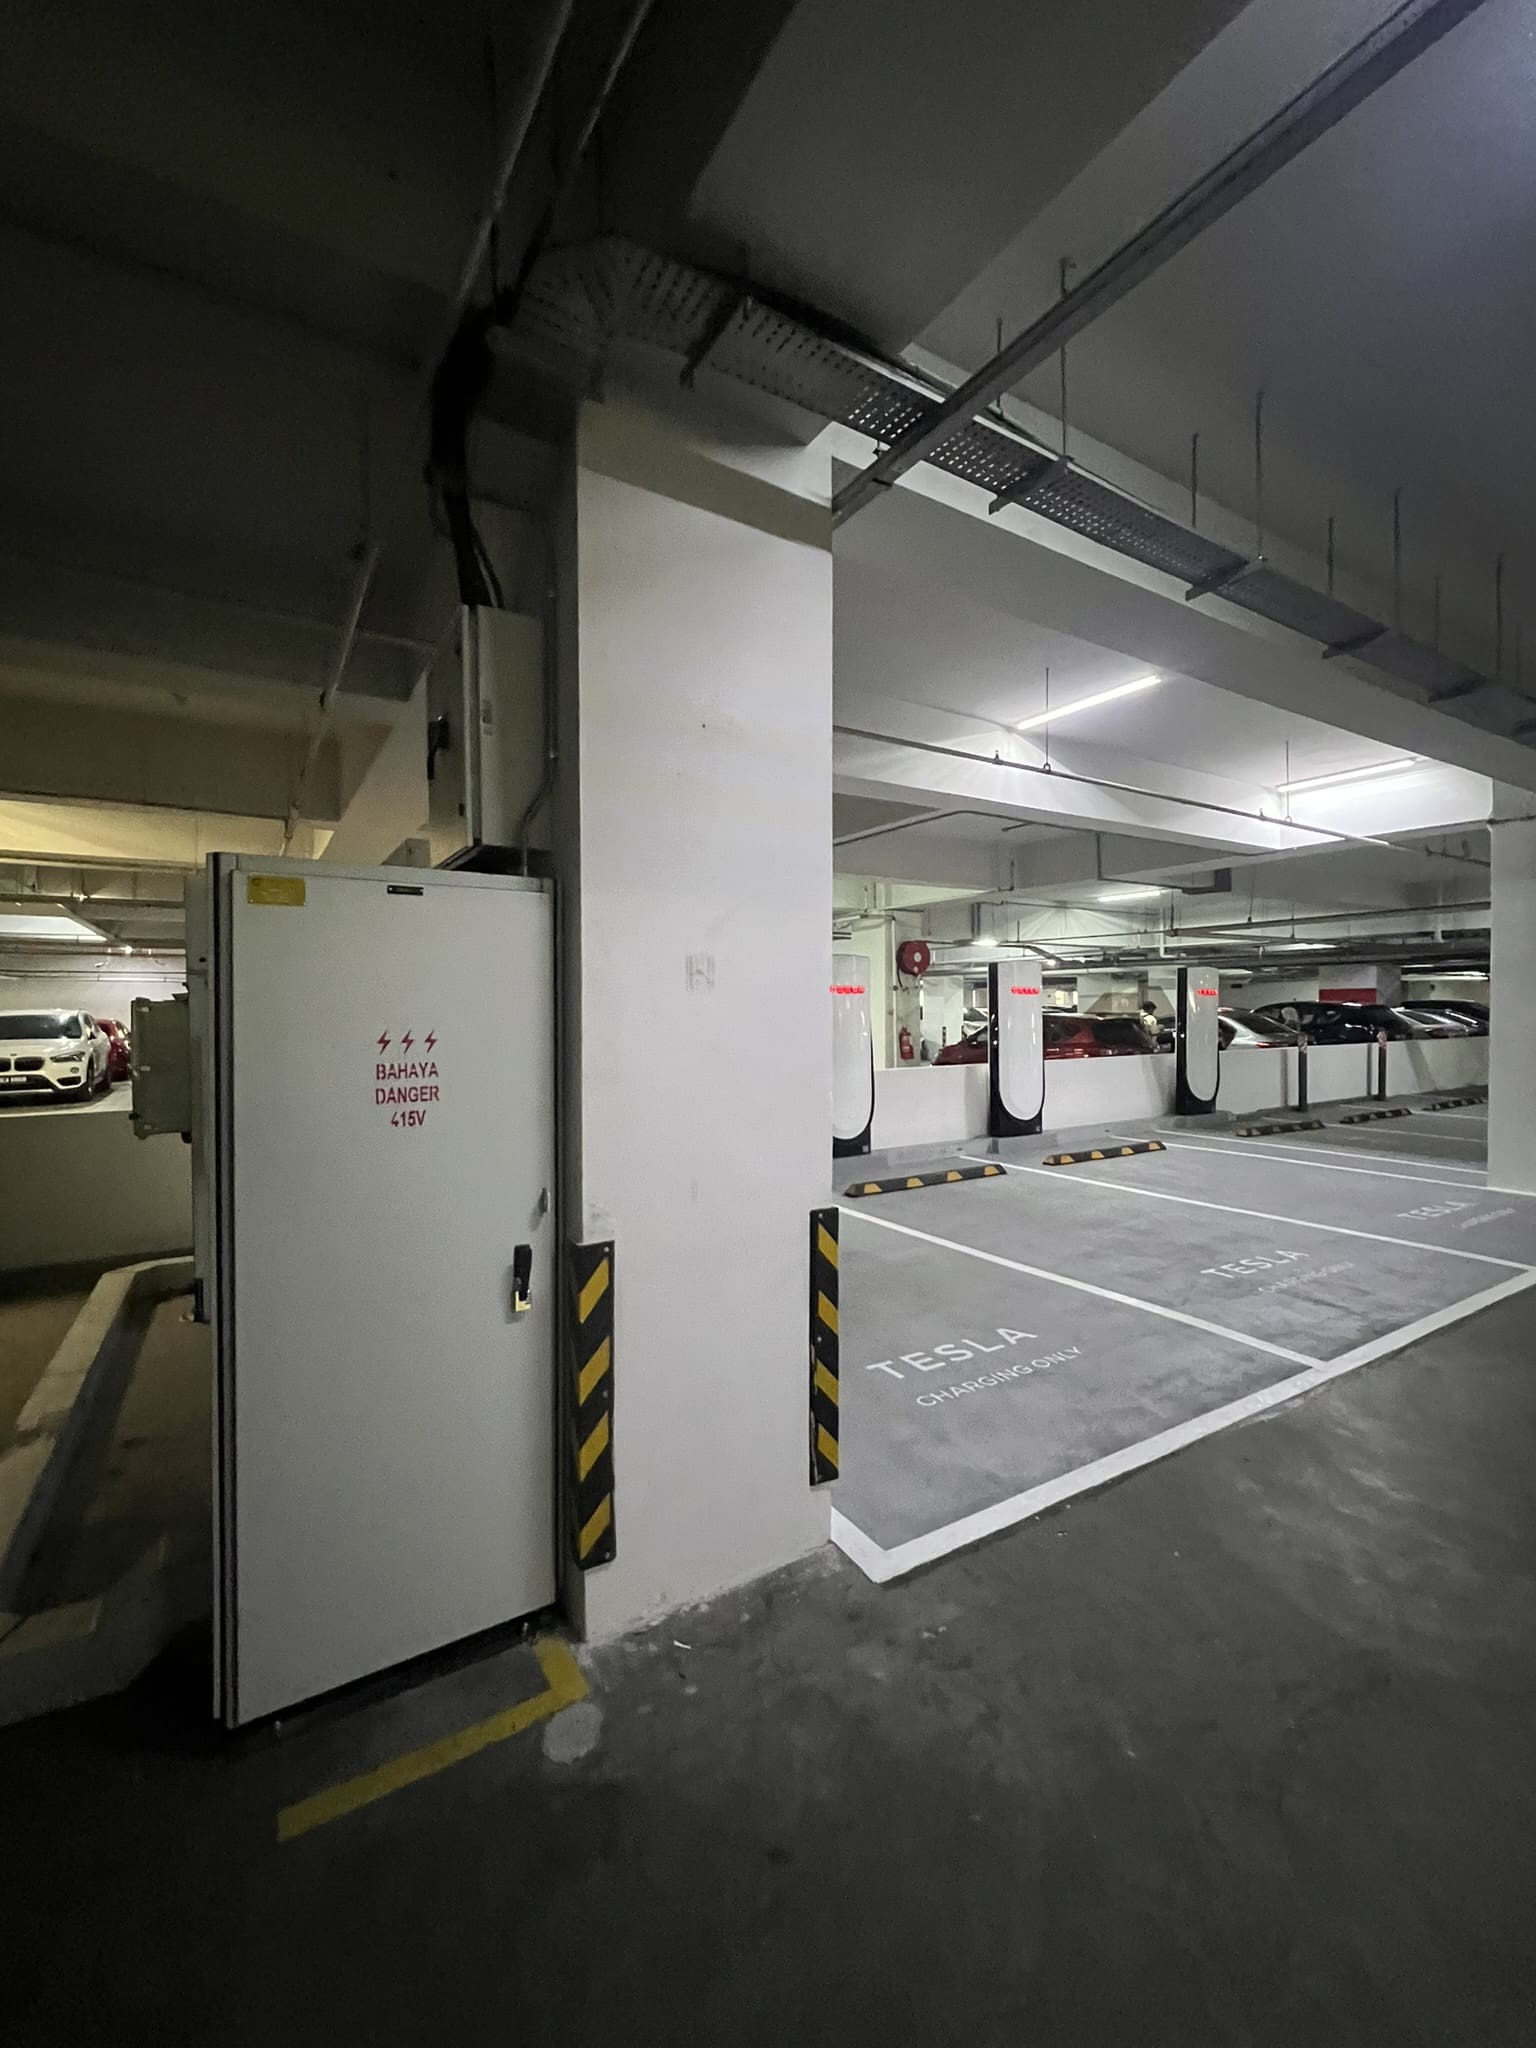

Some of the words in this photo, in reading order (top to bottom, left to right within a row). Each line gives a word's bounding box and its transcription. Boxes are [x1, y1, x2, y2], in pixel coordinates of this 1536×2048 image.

[376, 1062, 439, 1080] BAHAYA
[376, 1085, 440, 1105] DANGER
[391, 1110, 426, 1127] 415V
[1200, 1249, 1311, 1279] TESLA
[865, 1327, 1038, 1380] TESLA
[916, 1364, 1033, 1408] CHARGING
[1031, 1345, 1083, 1370] ONLY
